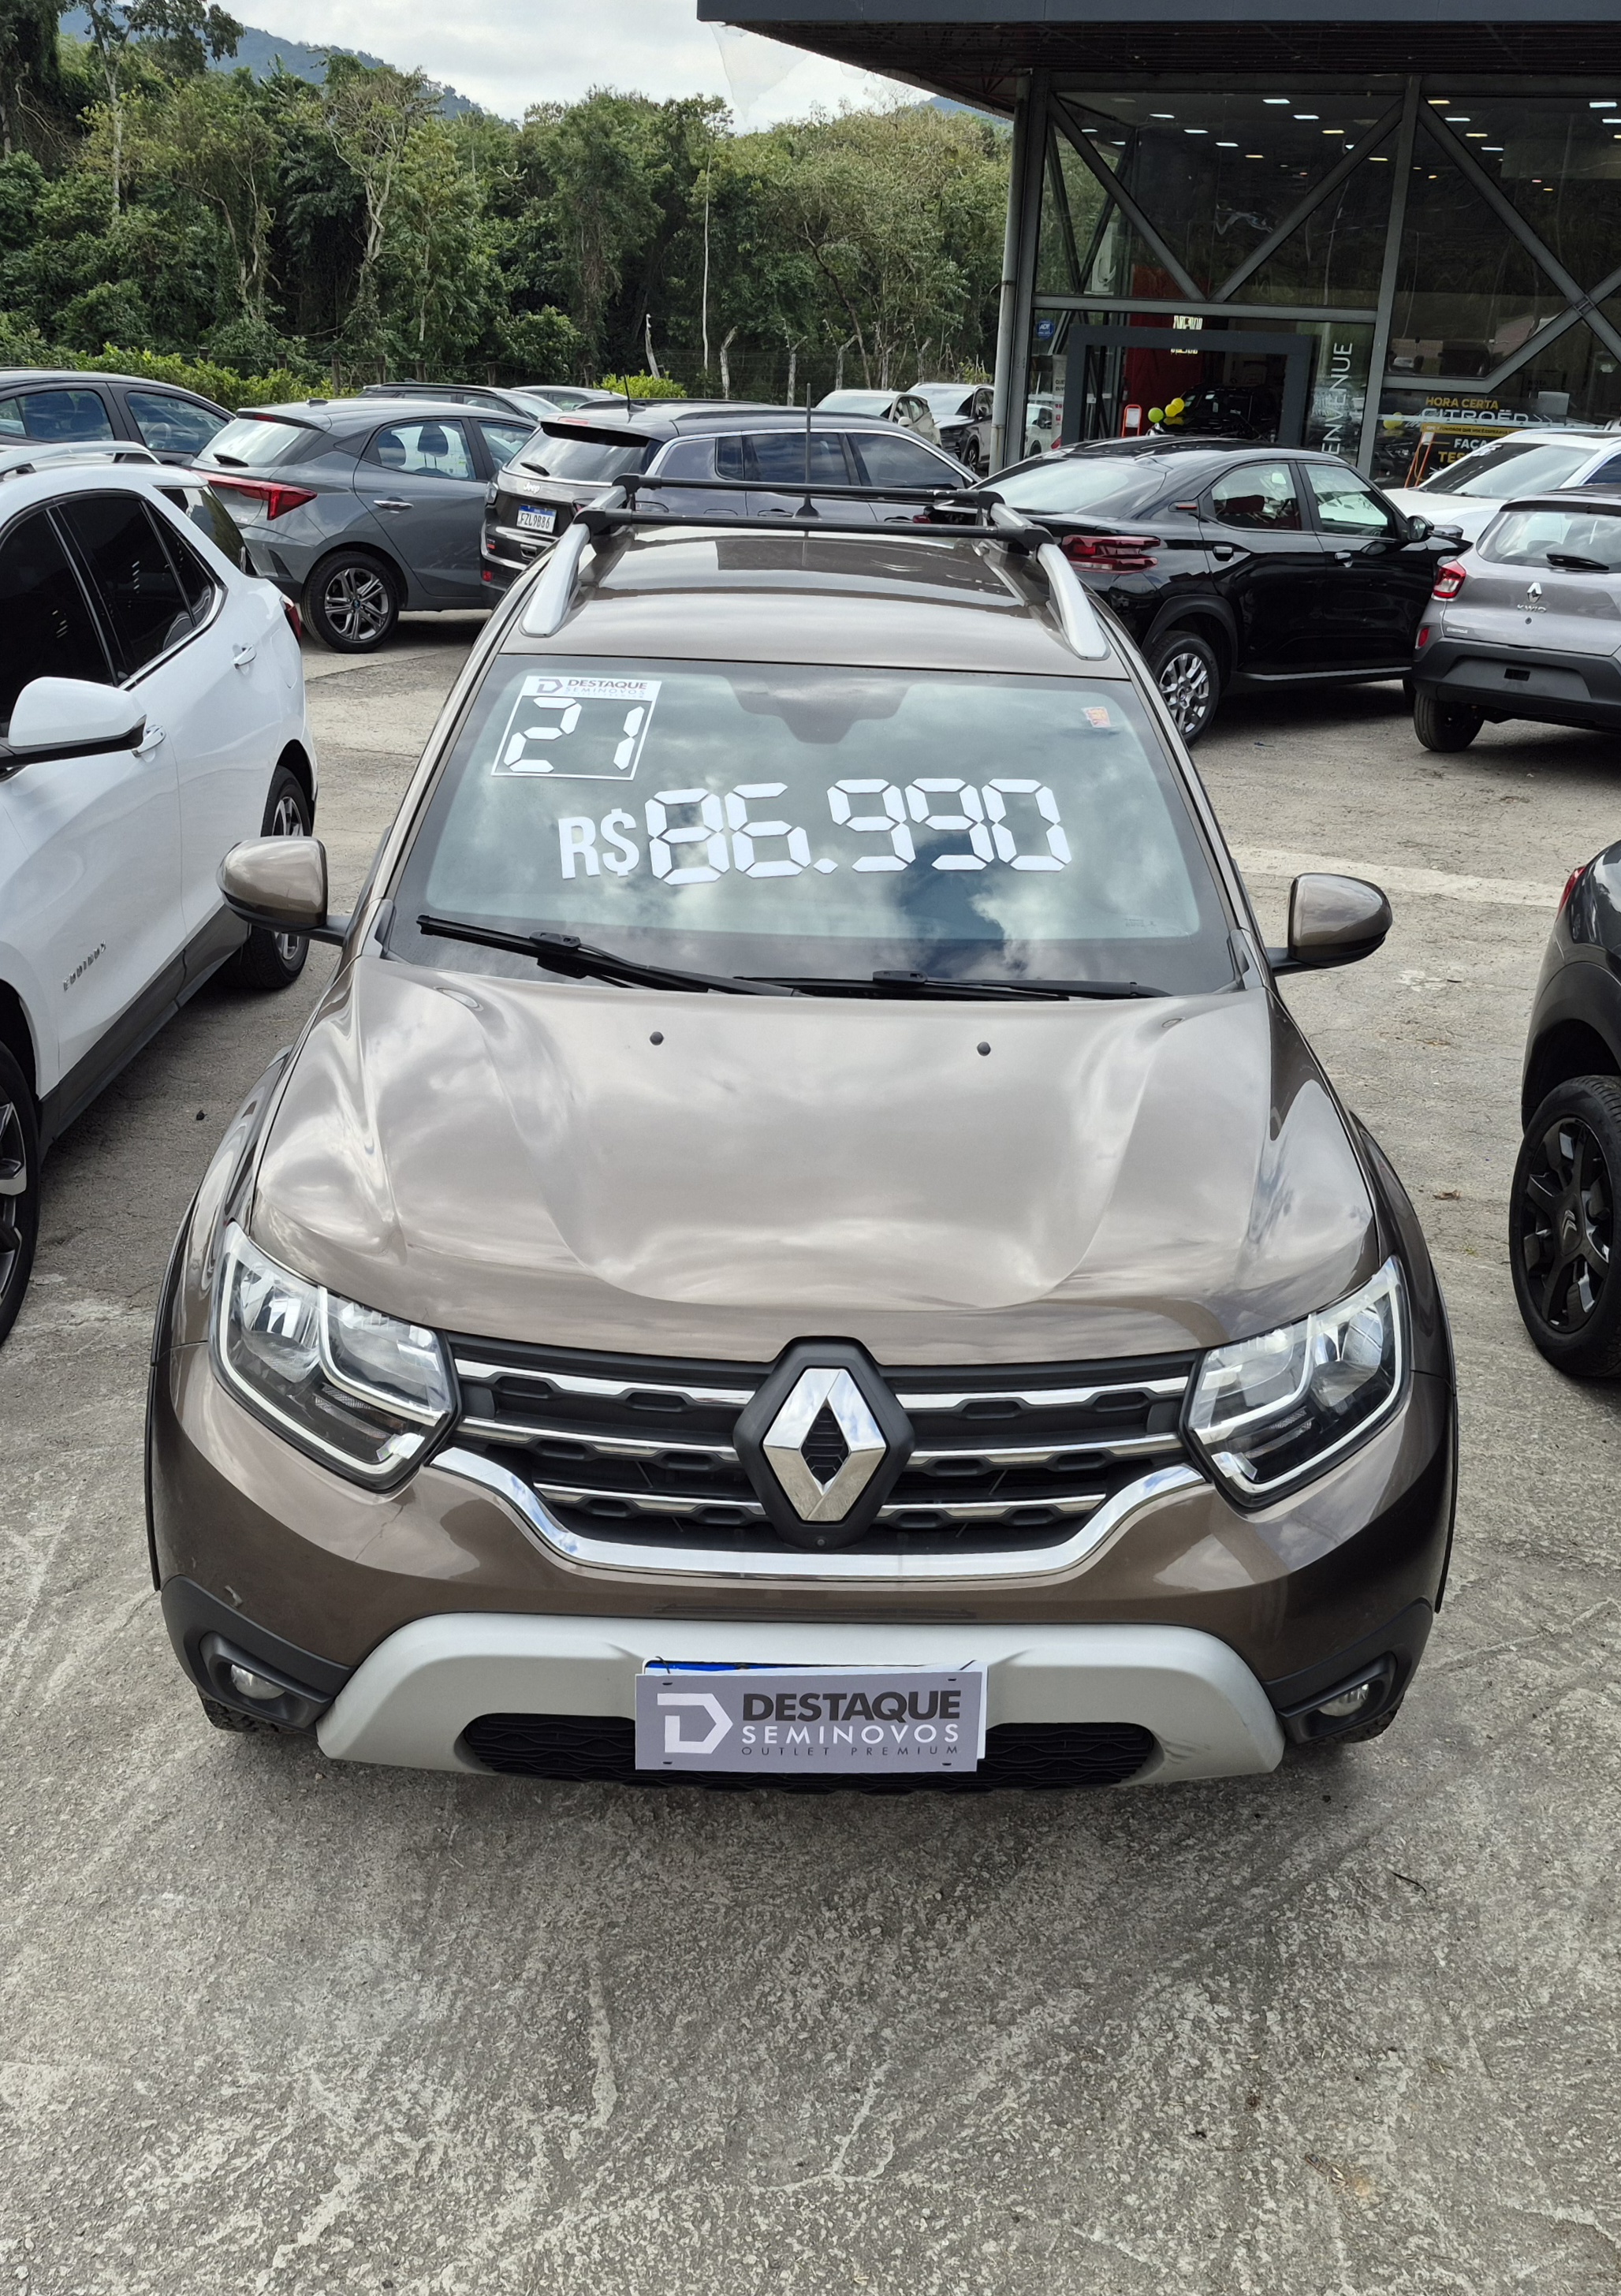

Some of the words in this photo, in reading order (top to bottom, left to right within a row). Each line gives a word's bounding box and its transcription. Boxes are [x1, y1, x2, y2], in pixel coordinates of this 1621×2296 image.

[1425, 396, 1459, 408] HORA
[1461, 398, 1499, 410] CERTA
[1438, 451, 1469, 464] TES
[524, 481, 541, 494] Jeep
[565, 687, 646, 695] SEMINOVOS
[567, 679, 648, 690] DESTAQUE
[504, 696, 645, 773] 21
[742, 1690, 961, 1723] DESTAQUE
[742, 1723, 959, 1744] SEMINOVOS
[742, 1746, 829, 1756] OUTLET
[851, 1745, 958, 1756] PREMIUM
